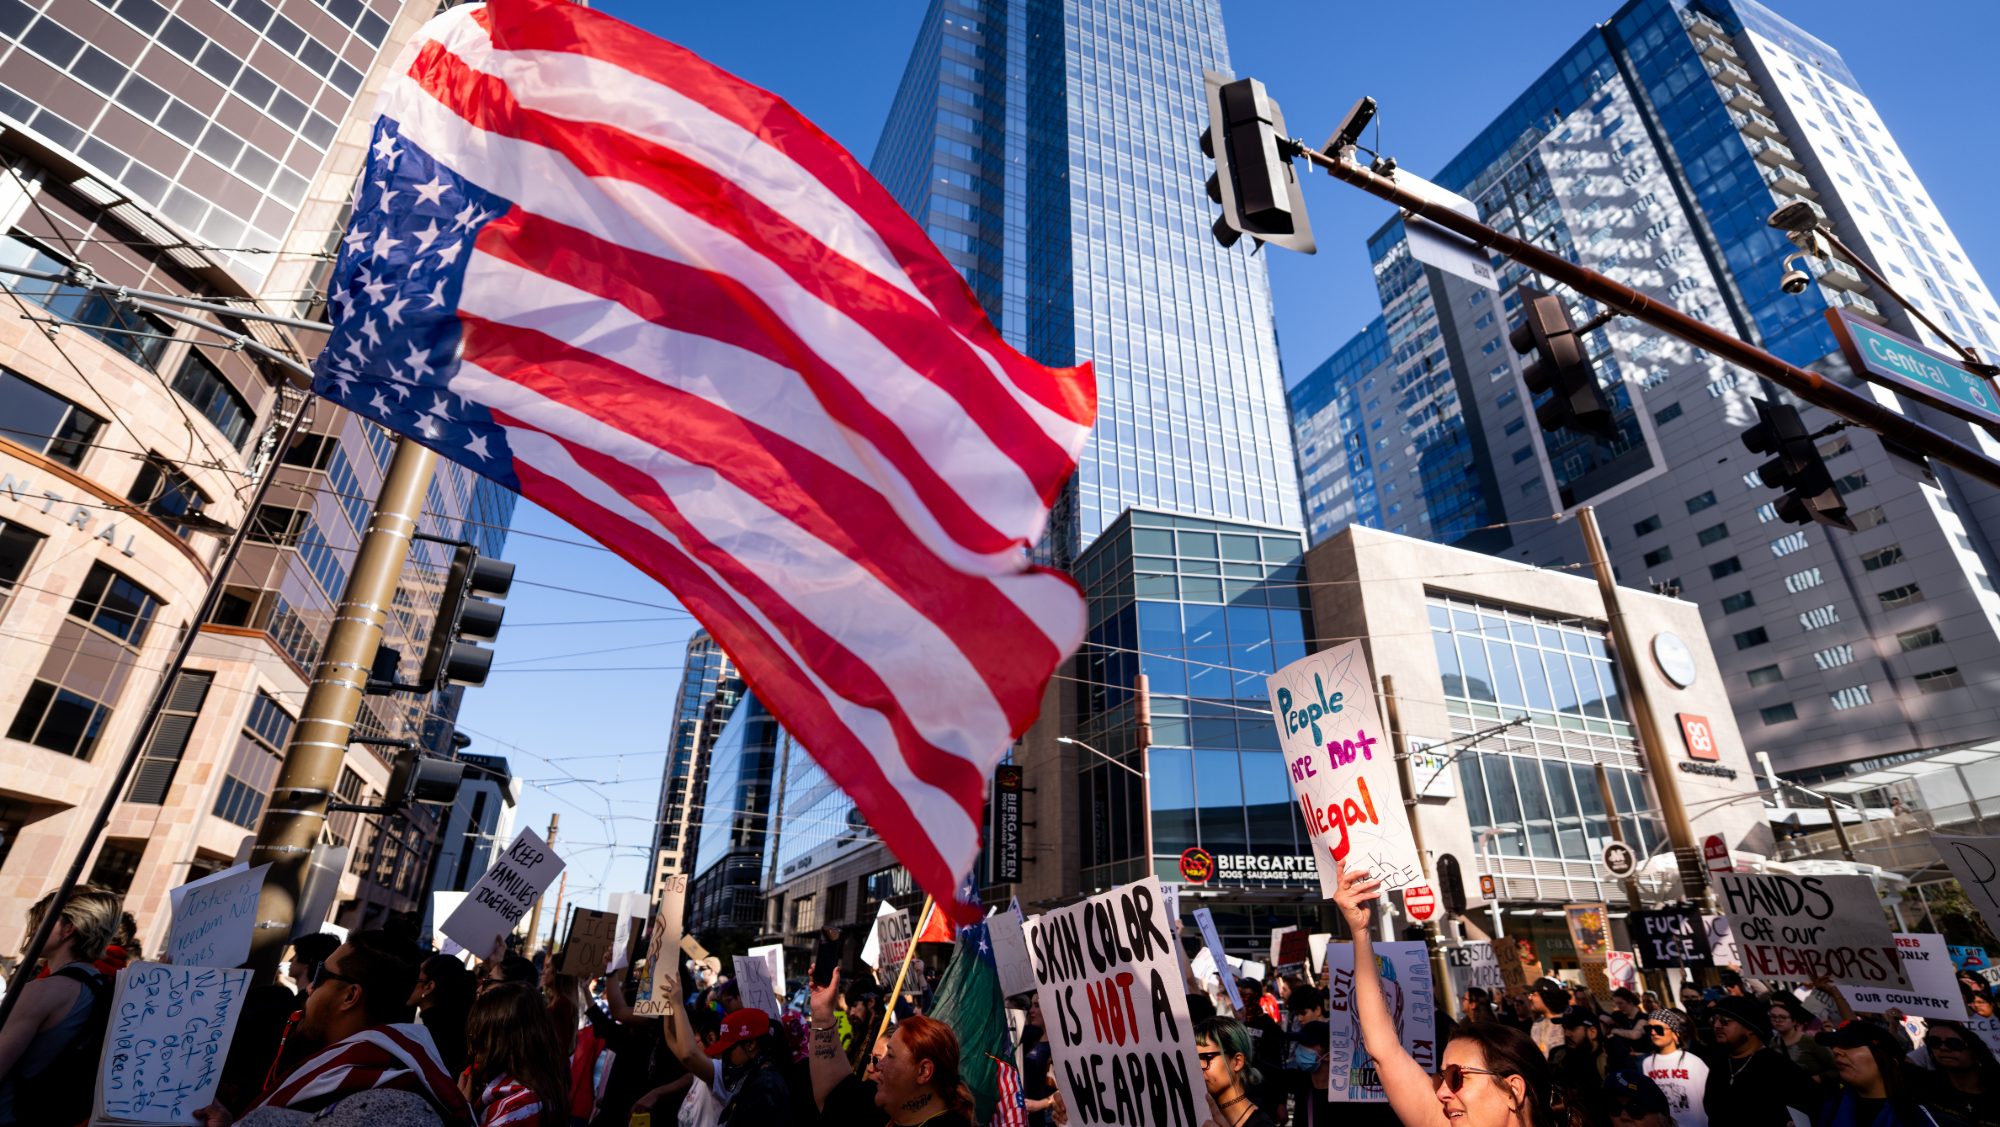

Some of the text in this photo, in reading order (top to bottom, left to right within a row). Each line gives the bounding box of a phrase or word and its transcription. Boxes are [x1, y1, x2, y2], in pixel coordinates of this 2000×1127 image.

[1868, 337, 1951, 389] Central
[1277, 672, 1344, 747] People
[1326, 729, 1377, 770] not
[508, 838, 545, 868] KEEP
[1007, 793, 1017, 878] BIERGARTEN
[489, 861, 539, 907] FAMILIES
[1219, 870, 1243, 879] DOGS
[1247, 871, 1289, 880] SAUSAGES
[1385, 864, 1420, 892] ICE
[229, 893, 259, 918] NOT
[475, 886, 523, 926] TOGETHER
[1411, 905, 1431, 914] ENTER
[1721, 876, 1834, 920] HANDS
[887, 914, 911, 941] ONE
[1031, 885, 1169, 985] SKIN COLOR
[1644, 914, 1694, 935] FUCK
[1741, 917, 1826, 945] off our
[129, 972, 145, 990] 3
[1744, 944, 1905, 985] NEIGHBORS!
[1056, 968, 1179, 1047] IS NOT A
[1332, 968, 1355, 1012] EVIL
[1406, 950, 1431, 1028] PUPPET
[1855, 992, 1949, 1009] OUR COUNTRY
[171, 970, 217, 1120] We Get the
[1967, 1020, 1999, 1031] ICE
[1064, 1049, 1197, 1127] WEAPON
[1672, 1069, 1689, 1080] ICE
